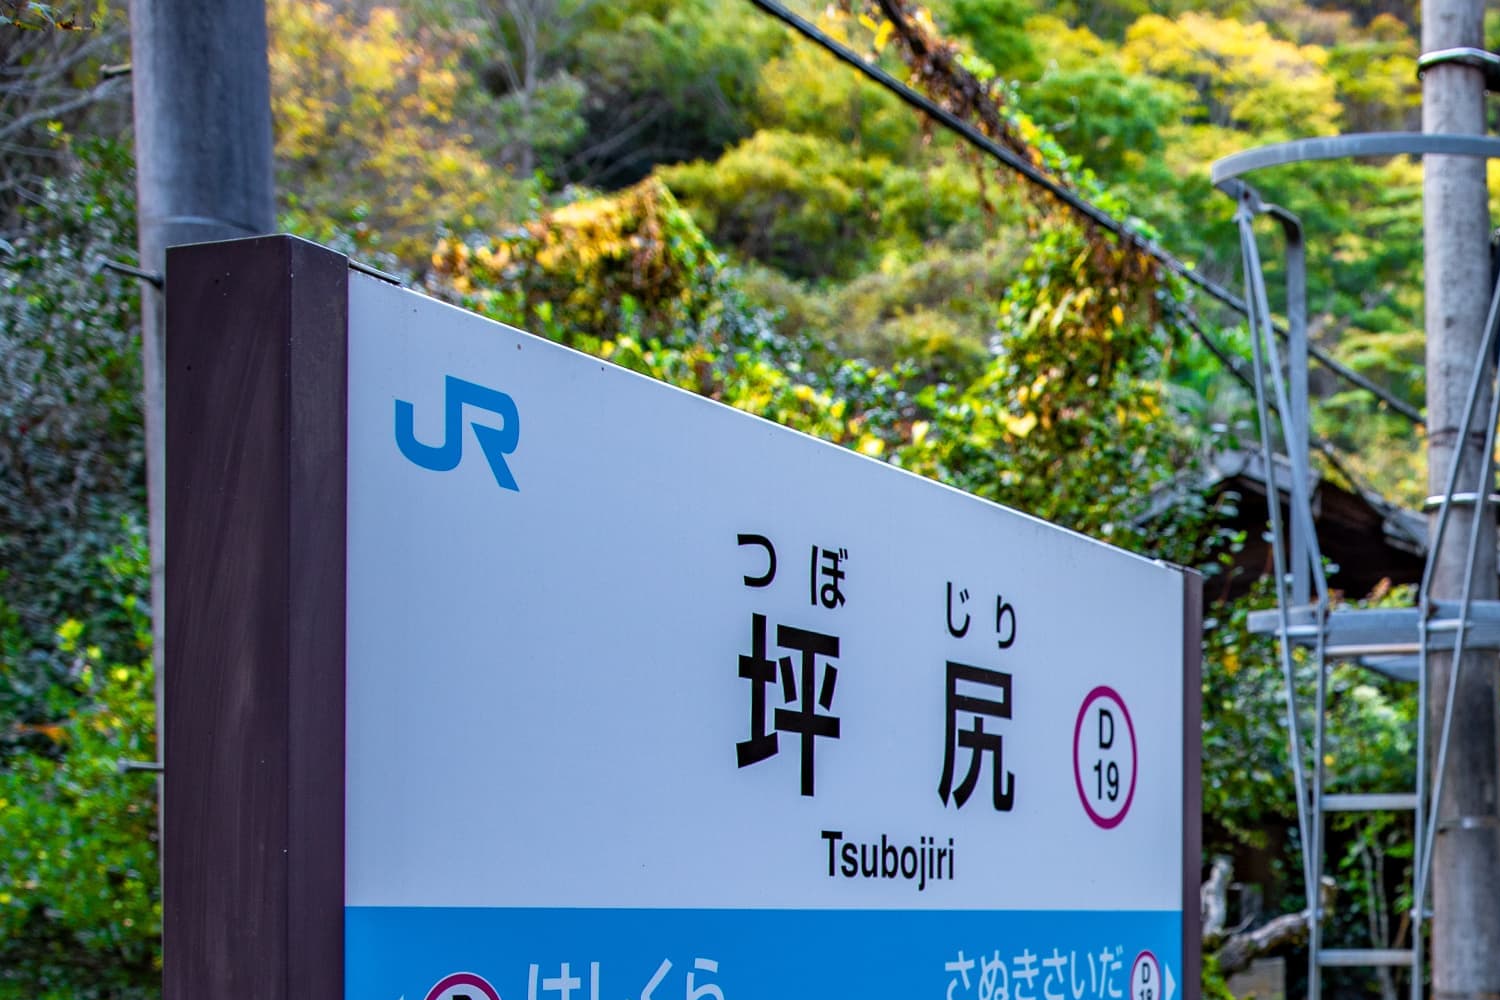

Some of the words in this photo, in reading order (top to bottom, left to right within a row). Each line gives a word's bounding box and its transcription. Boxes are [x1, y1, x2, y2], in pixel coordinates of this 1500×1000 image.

[395, 375, 520, 491] JR
[1098, 708, 1115, 750] D
[1093, 759, 1119, 802] 19
[821, 830, 955, 891] Tsubojiri
[1141, 962, 1151, 985] D
